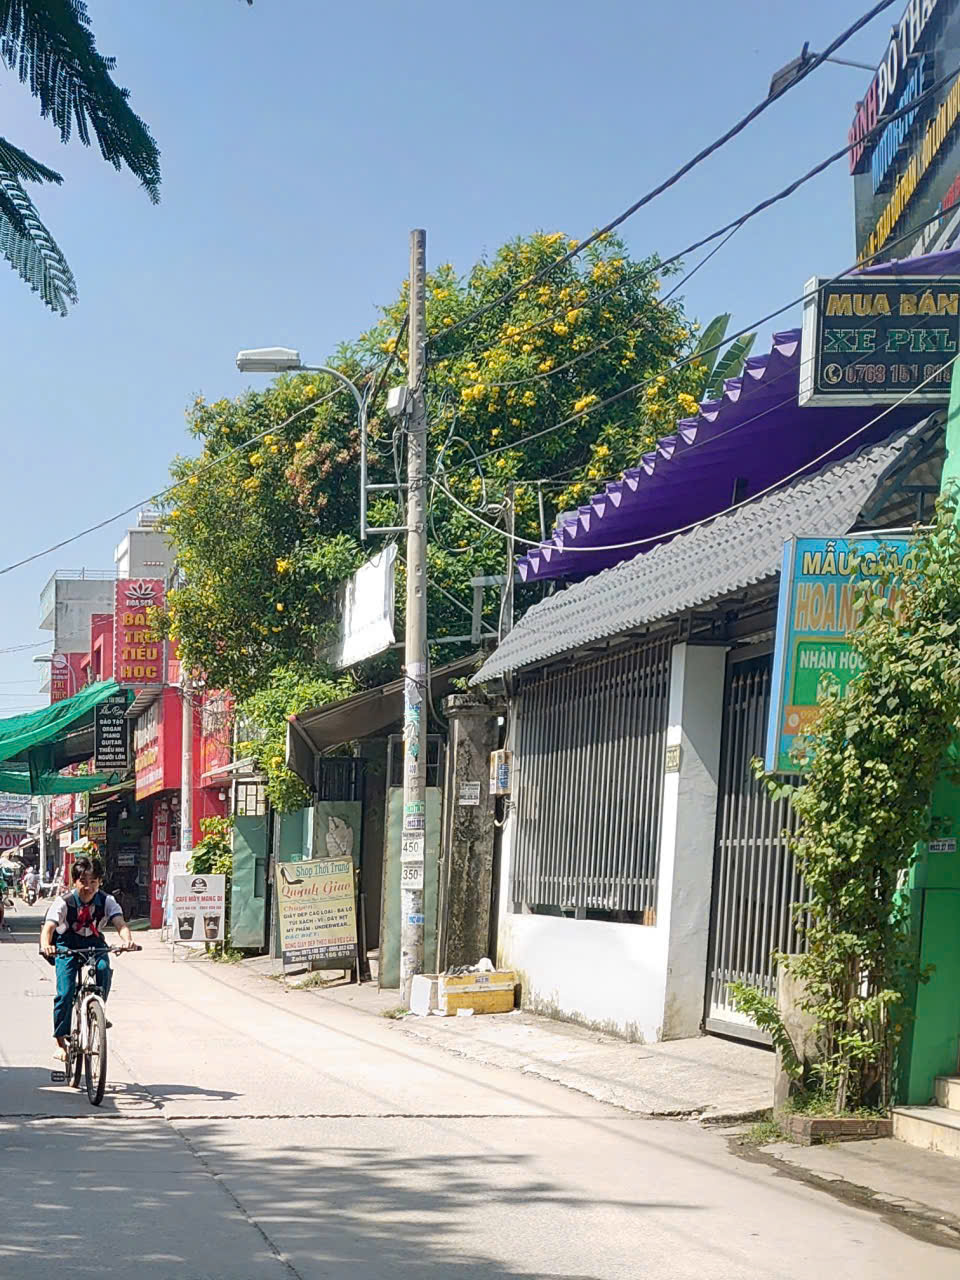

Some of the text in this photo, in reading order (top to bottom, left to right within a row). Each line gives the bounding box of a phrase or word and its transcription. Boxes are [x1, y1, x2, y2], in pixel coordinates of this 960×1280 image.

[826, 289, 959, 316] MUA BÁN
[824, 328, 957, 352] XE PKL
[794, 582, 839, 632] HOA
[800, 645, 837, 674] NHẬN
[403, 841, 419, 852] 450
[296, 866, 313, 878] Shop
[331, 862, 350, 874] Trang
[323, 880, 351, 896] Giao
